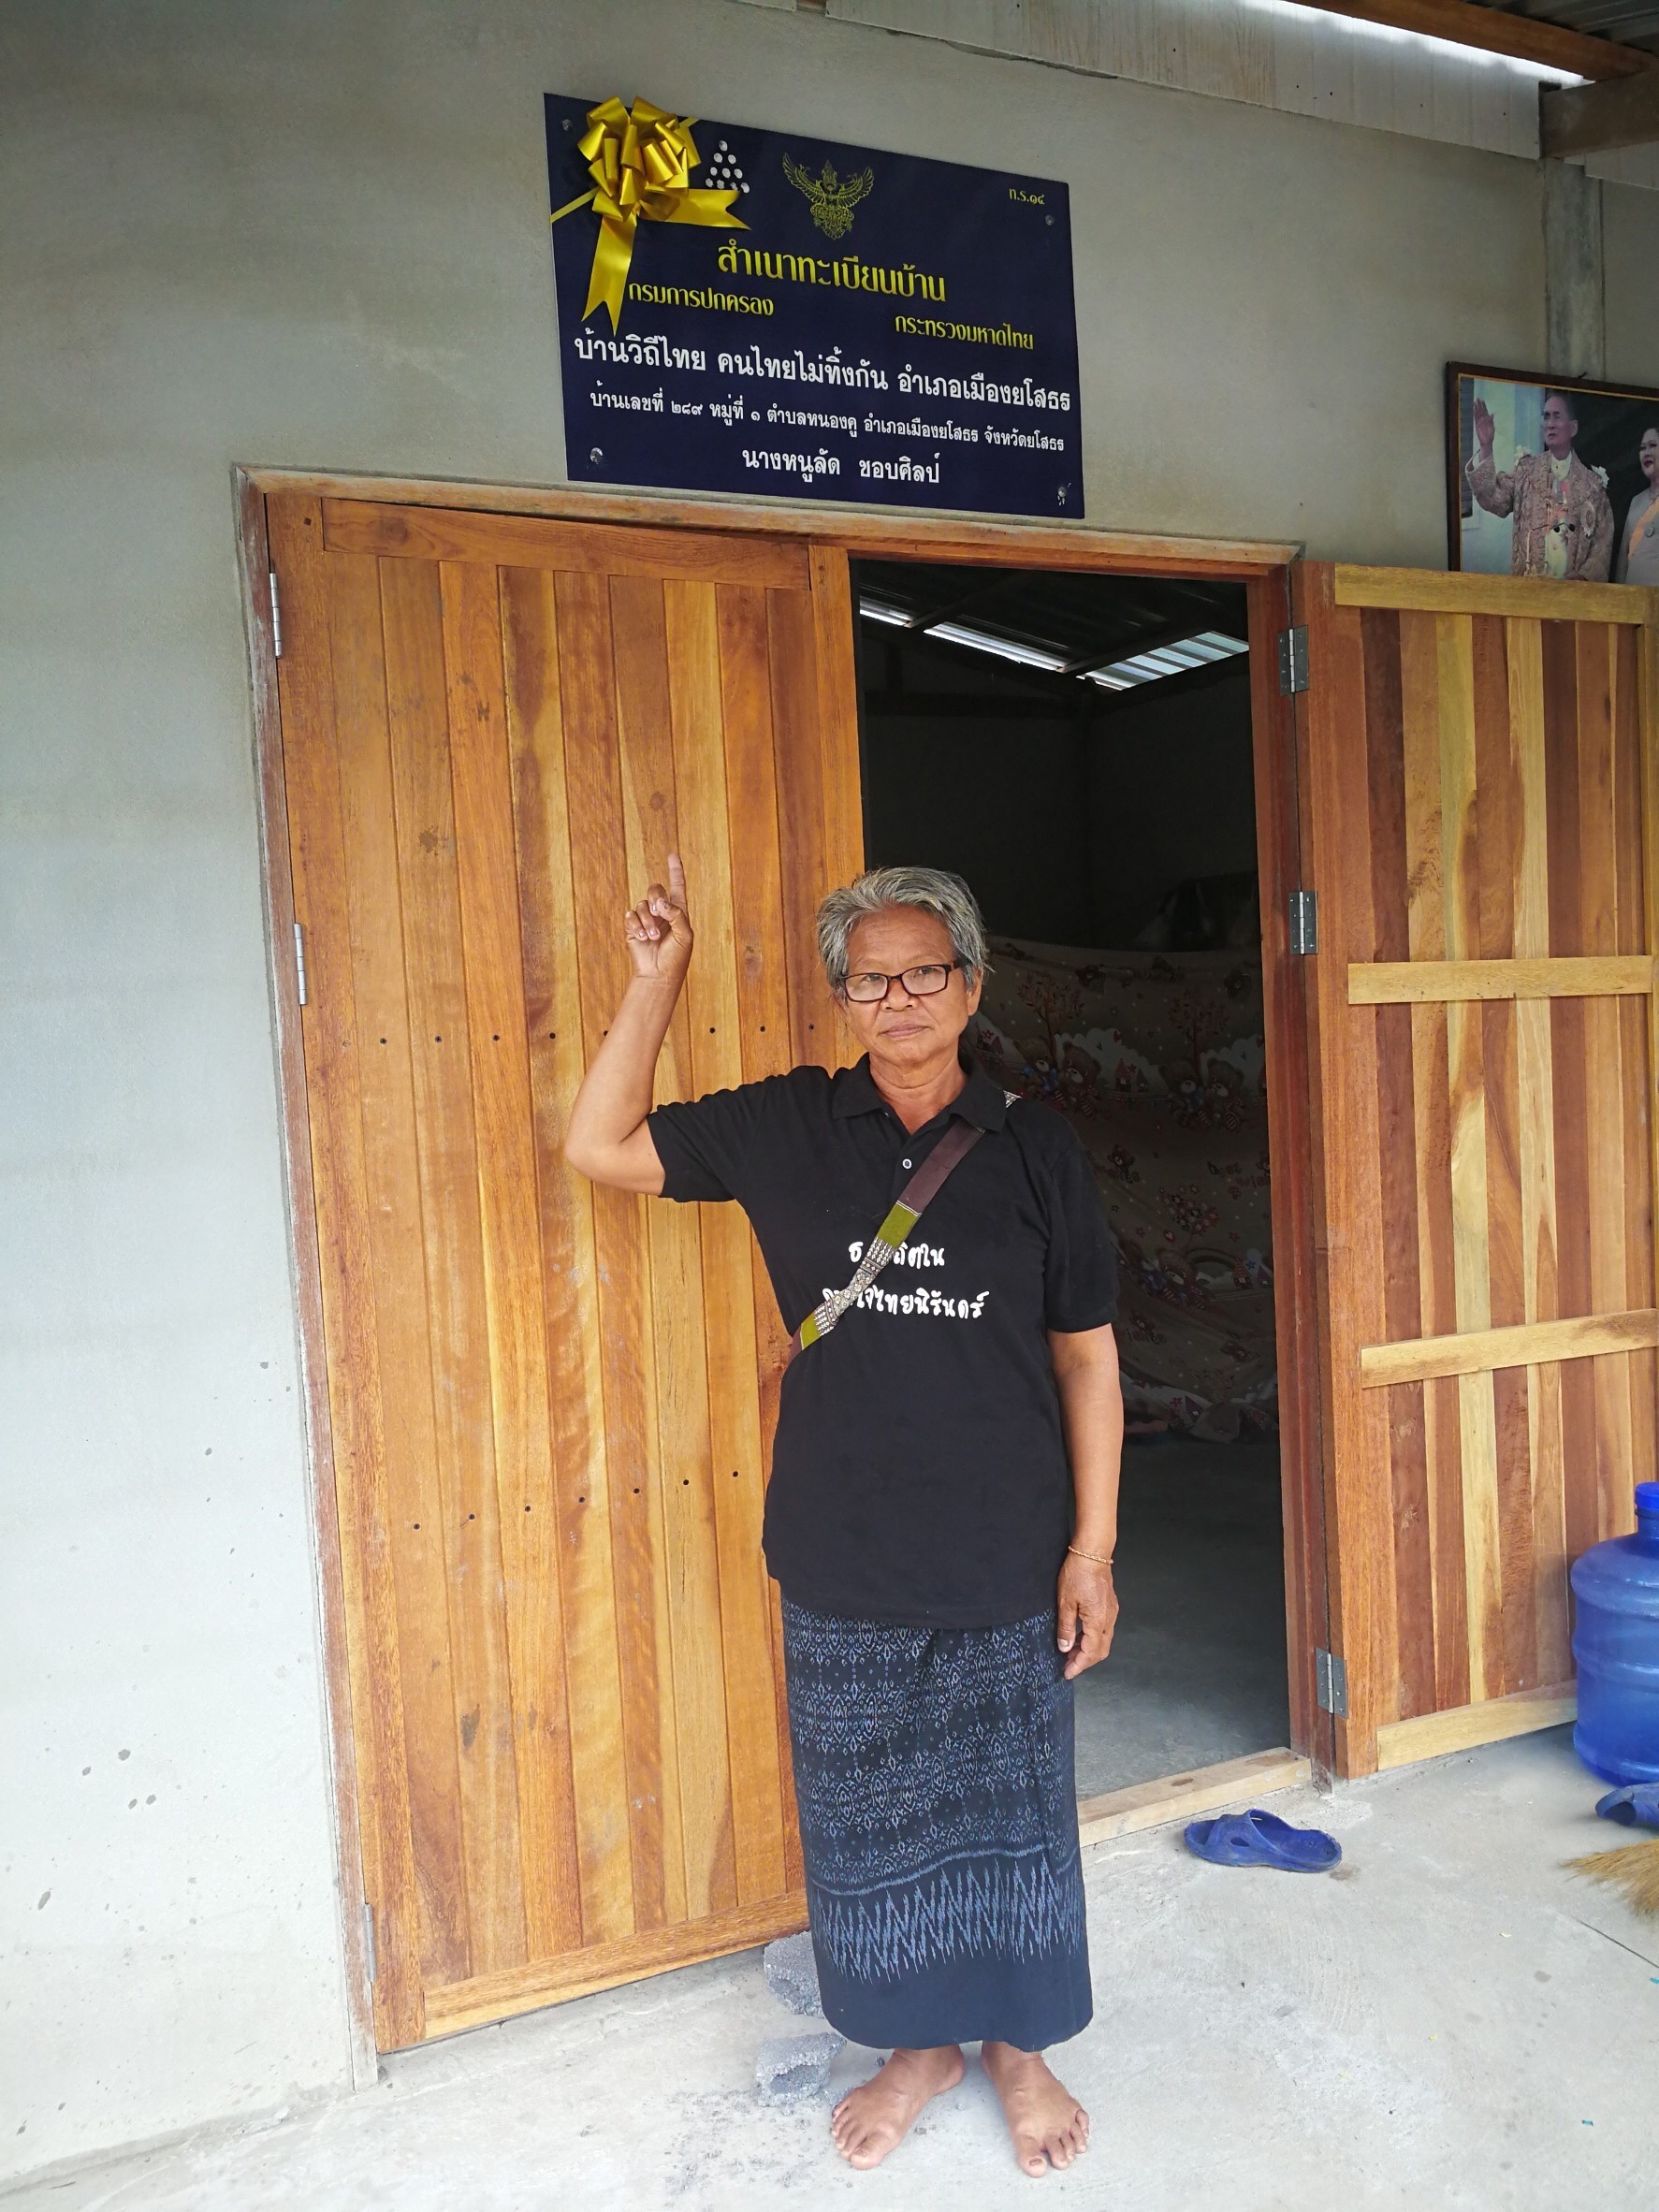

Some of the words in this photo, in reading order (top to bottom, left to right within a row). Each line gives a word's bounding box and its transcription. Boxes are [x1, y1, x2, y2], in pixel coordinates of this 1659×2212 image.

[718, 238, 946, 302] สำเนาทะเบียนบ้าน
[629, 283, 774, 316] กรมการปกครอง
[895, 315, 1034, 350] กระทรวงมหาดไทย
[574, 327, 706, 371] บ้านวิถีไทย
[718, 345, 889, 391] คนไทยไม่ทิ้งกัน
[897, 363, 1070, 412] อำเภอเมืองยโสธร
[589, 379, 663, 413] บ้านเลขที่
[671, 400, 704, 415] ๒๘๙
[708, 393, 744, 427] หมู่ที่
[750, 411, 761, 422] ๑
[766, 402, 858, 438] ตำบลหนองคู
[864, 412, 979, 443] อำเภอเมืองยโสธร
[983, 425, 1065, 452] จังหวัดยโสธร
[742, 447, 841, 484] นางหนูลัด
[858, 451, 940, 484] ชอบศิลป์
